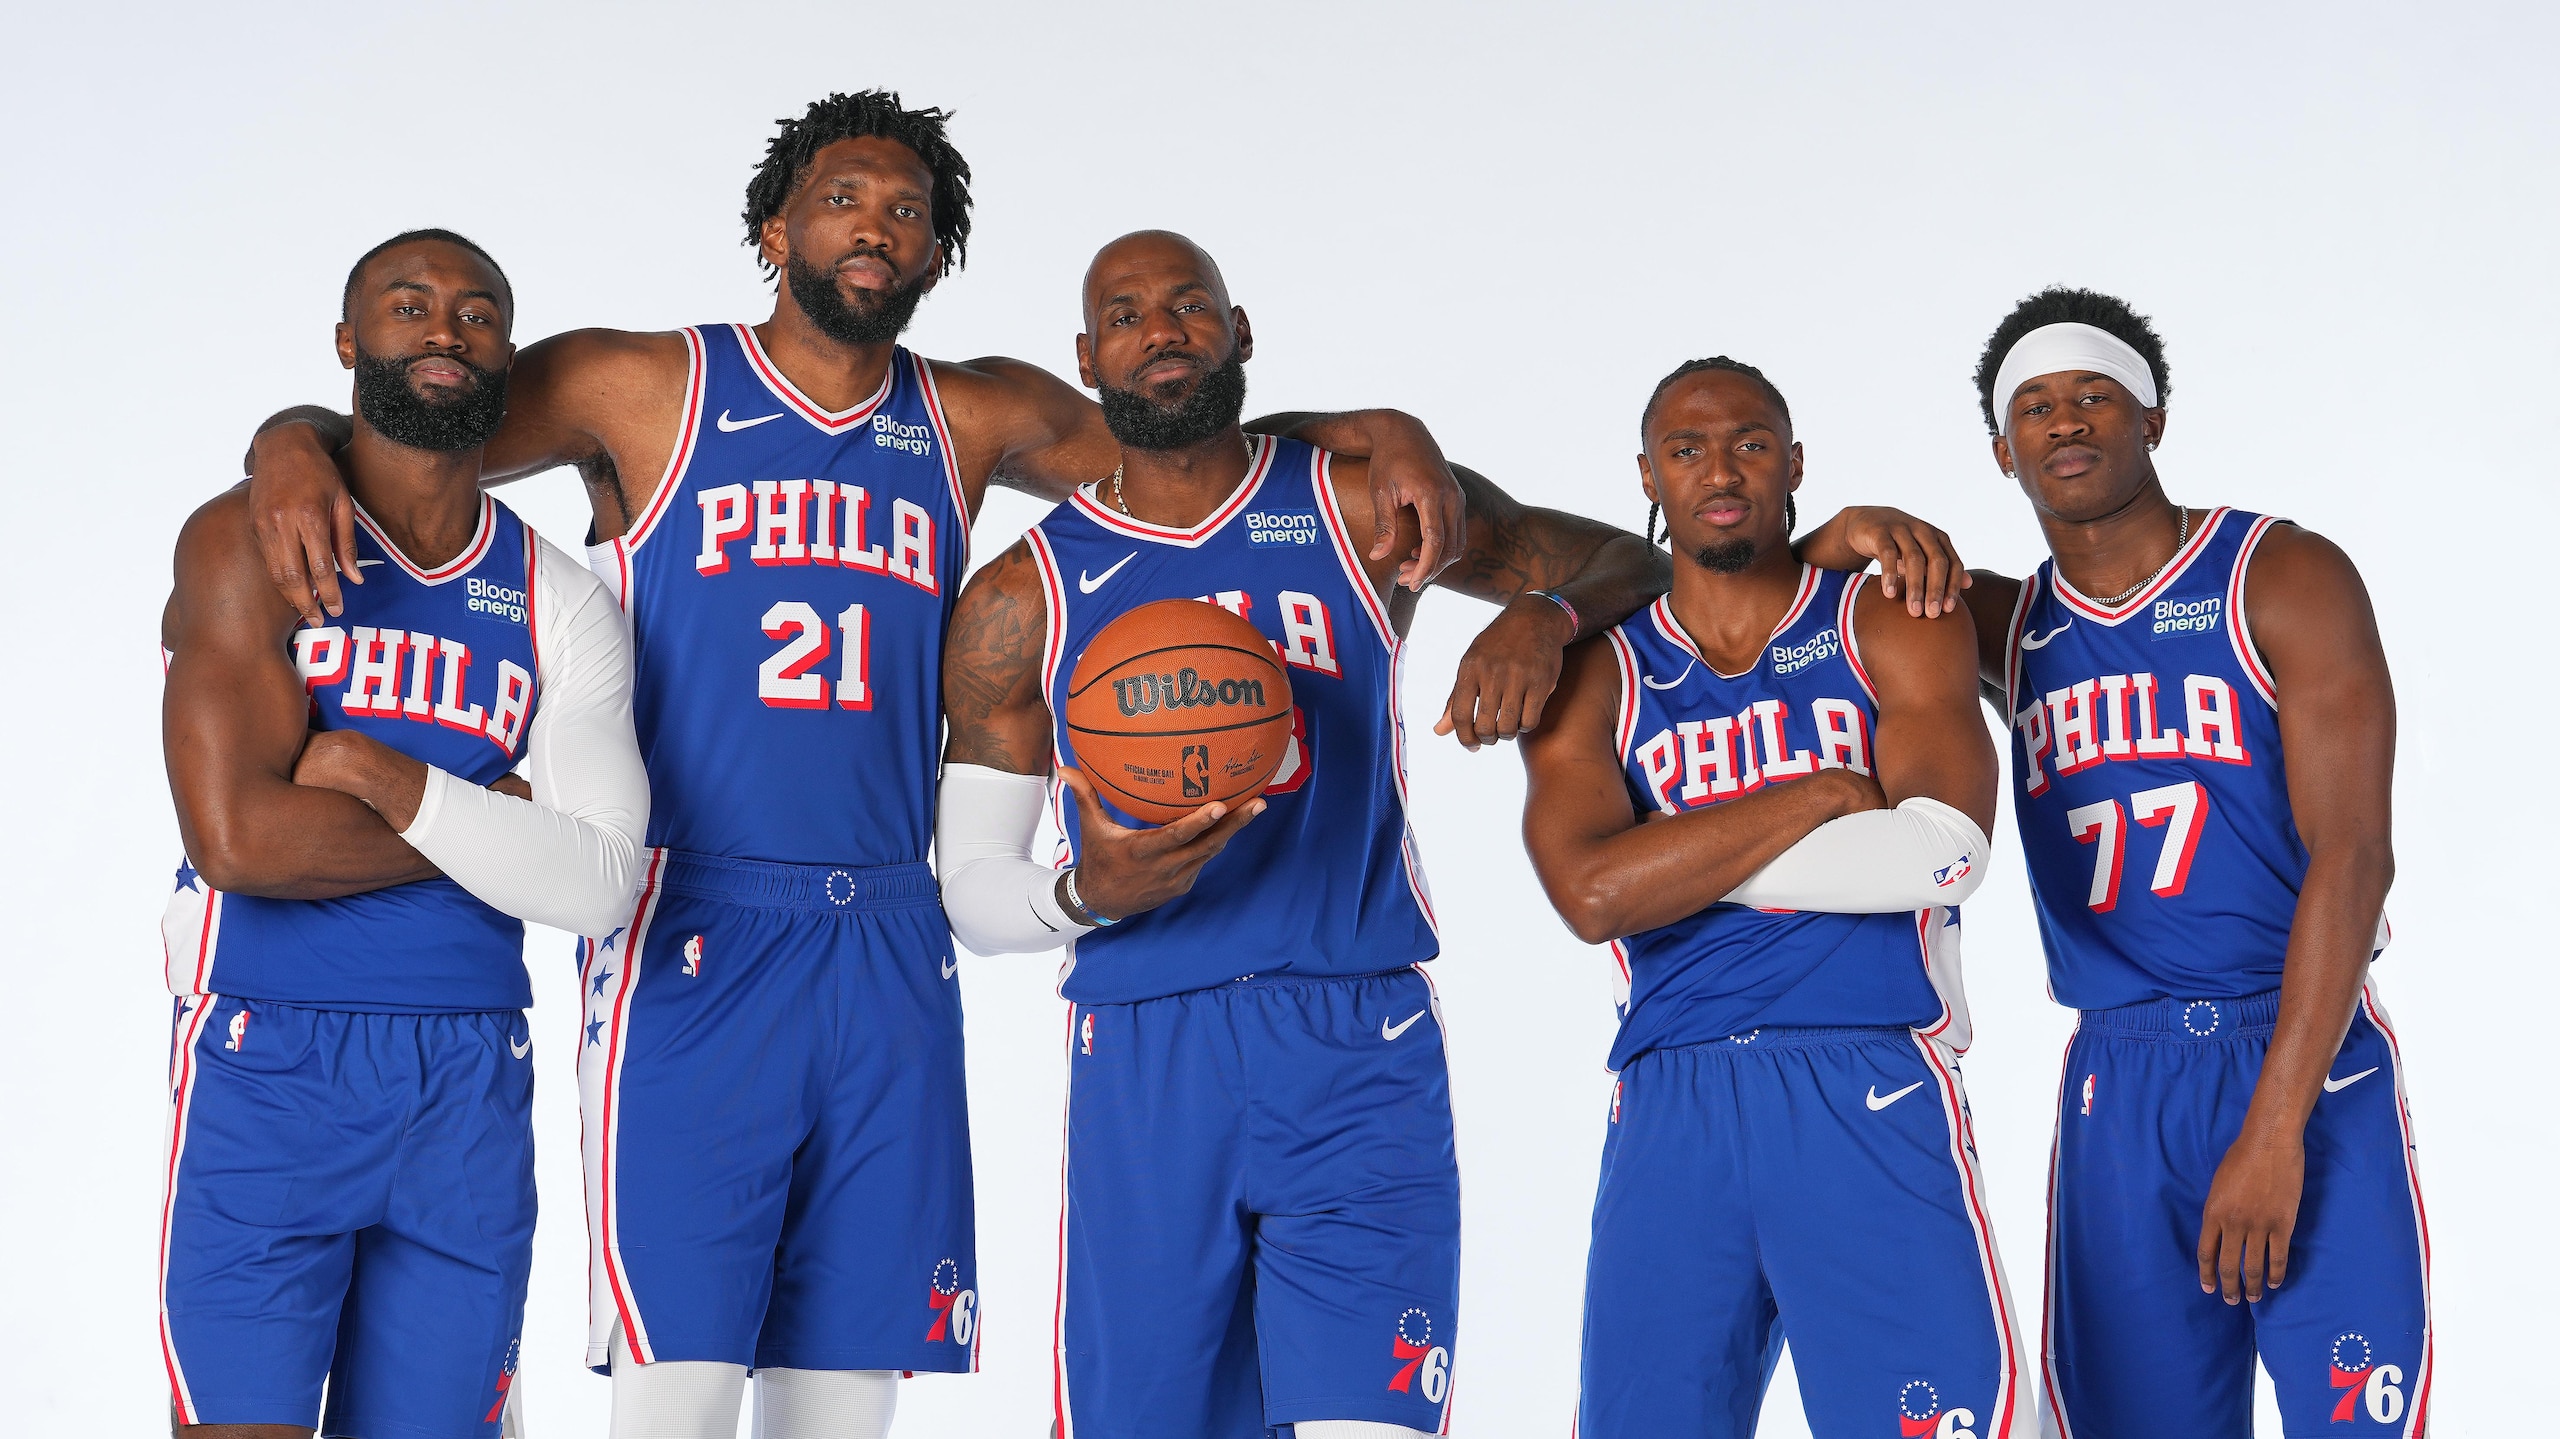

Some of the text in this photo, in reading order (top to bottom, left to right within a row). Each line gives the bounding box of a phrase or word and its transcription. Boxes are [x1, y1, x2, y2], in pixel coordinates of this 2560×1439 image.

[873, 415, 930, 439] Bloom
[875, 434, 931, 456] energy
[1246, 512, 1316, 529] Bloom
[1249, 527, 1317, 544] energy
[696, 479, 940, 597] PHILA
[467, 578, 527, 606] Bloom
[2153, 598, 2220, 620] Bloom
[468, 598, 528, 624] energy
[2153, 610, 2220, 634] energy
[758, 601, 873, 711] 21
[1772, 629, 1838, 663] Bloom
[1775, 642, 1839, 674] energy
[293, 626, 534, 760] PHILA
[1112, 667, 1266, 717] Wilson
[2016, 672, 2252, 799] PHILA
[1124, 763, 1174, 778] OFFICIAL GAME BALL
[1634, 697, 1875, 816] PHILA
[2066, 780, 2209, 914] 77
[925, 1286, 975, 1345] 76
[1387, 1334, 1448, 1404] 76
[2329, 1364, 2404, 1424] 76
